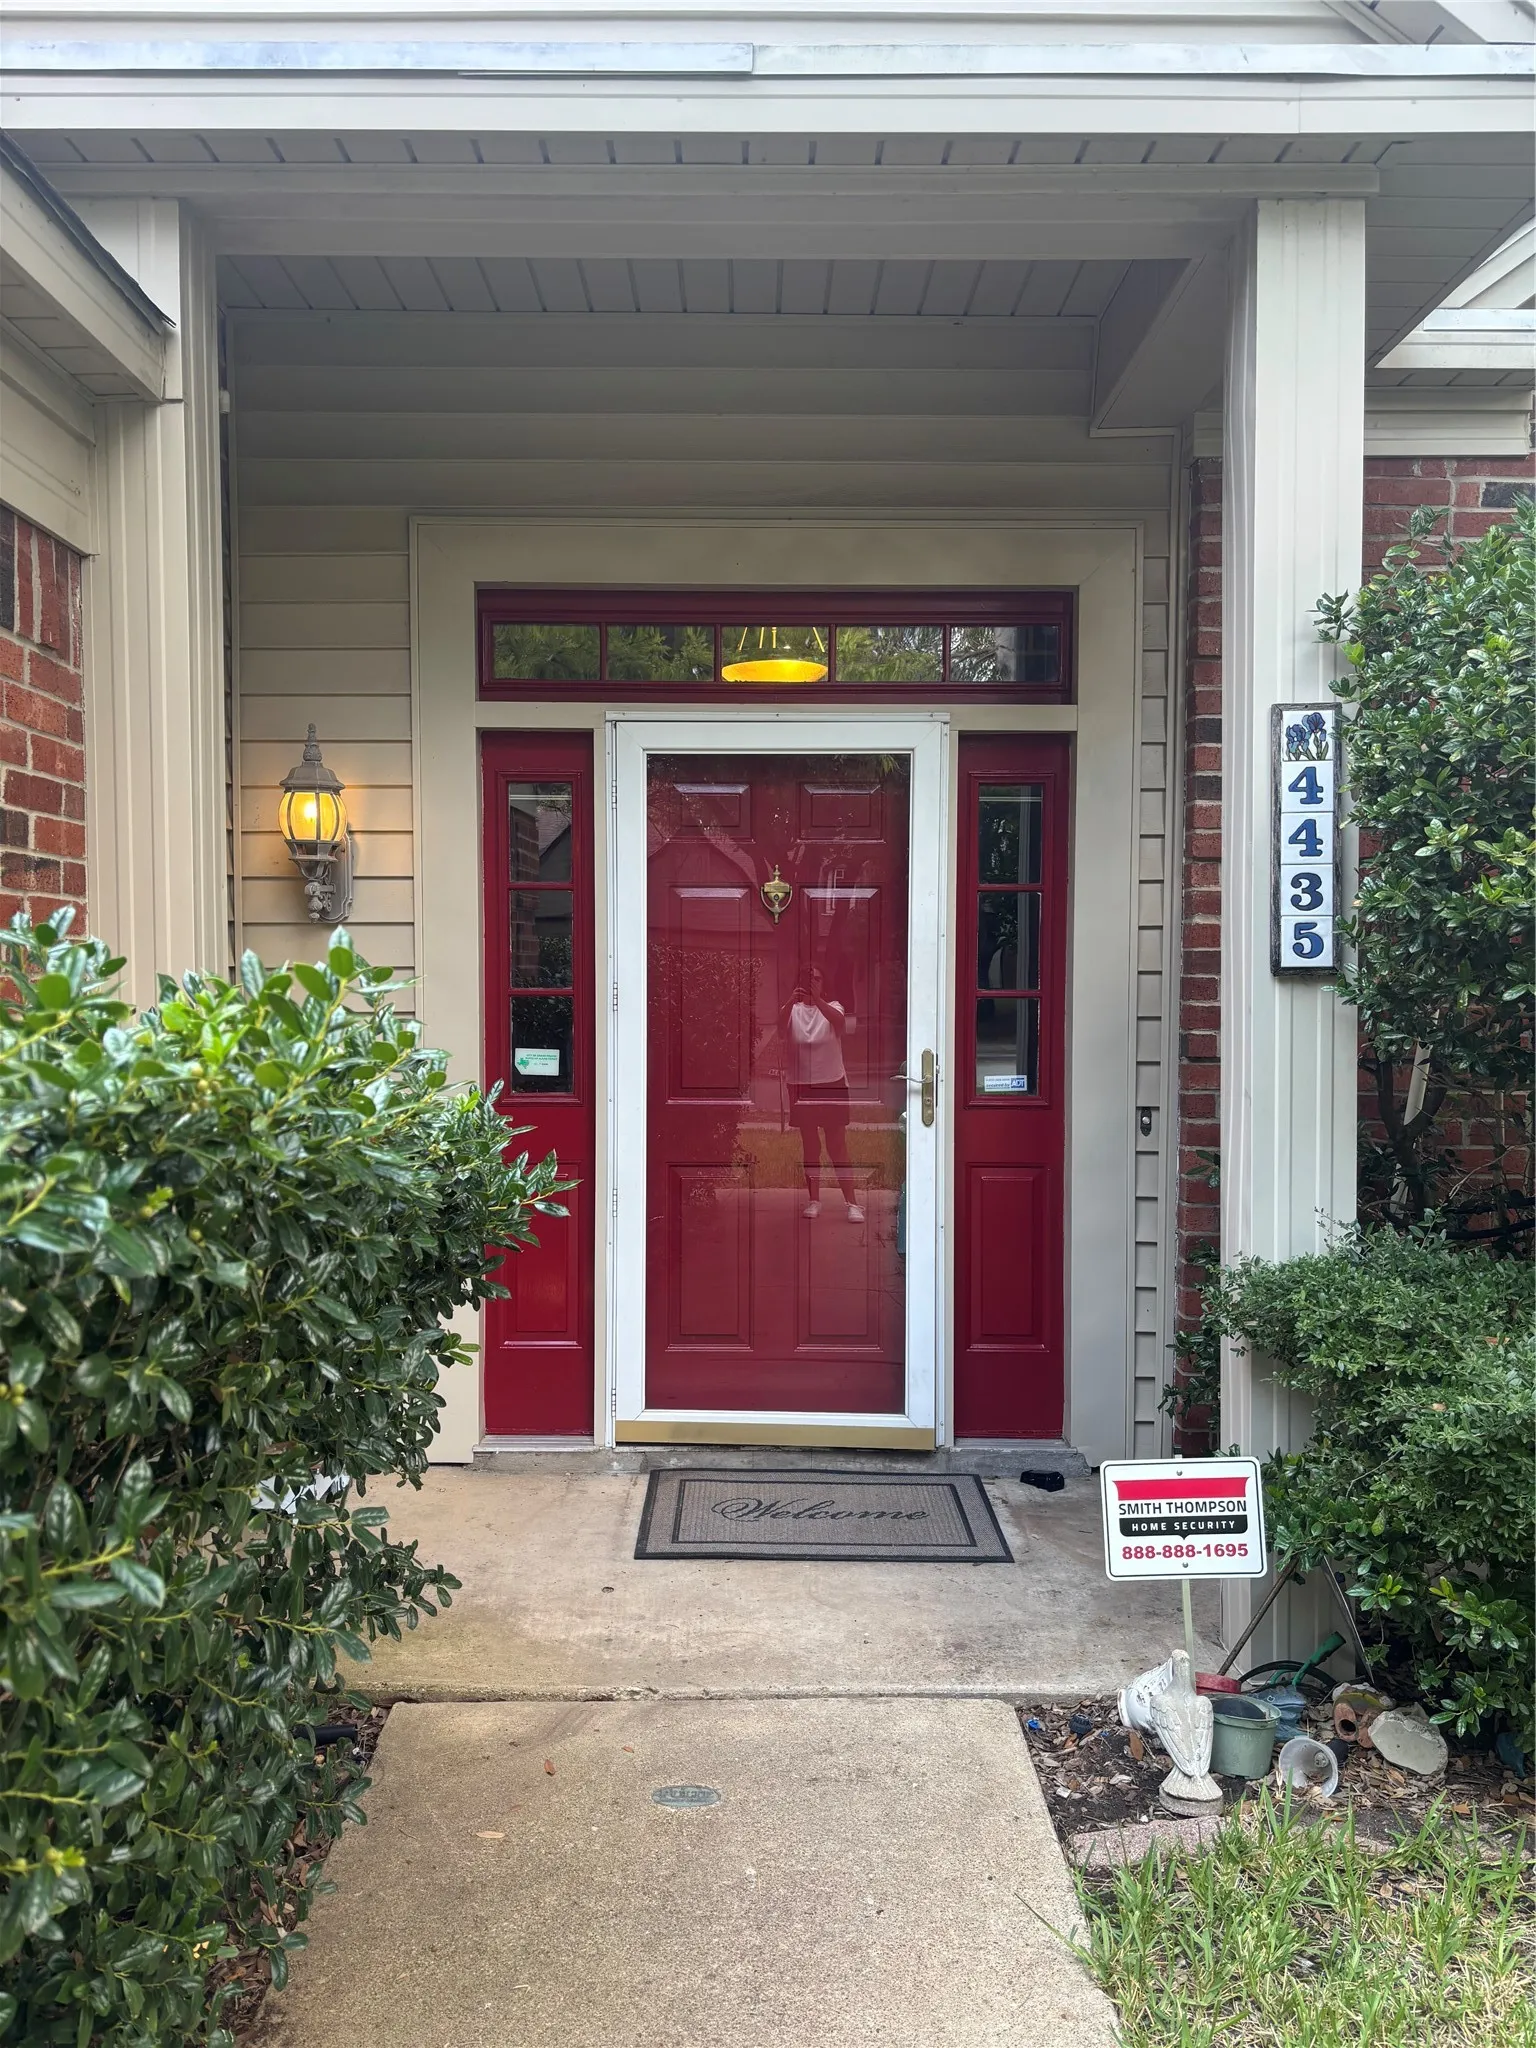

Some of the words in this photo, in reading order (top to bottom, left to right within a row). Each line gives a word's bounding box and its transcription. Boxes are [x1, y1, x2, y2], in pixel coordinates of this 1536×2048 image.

[1288, 766, 1325, 959] 4435
[1011, 1079, 1025, 1087] ADT
[711, 1497, 931, 1522] Welcome
[1118, 1502, 1162, 1515] SMITH
[1166, 1500, 1247, 1514] THOMPSON
[1131, 1522, 1167, 1532] HOME
[1174, 1520, 1236, 1530] SECURITY
[1122, 1543, 1249, 1560] 888-888-1695
